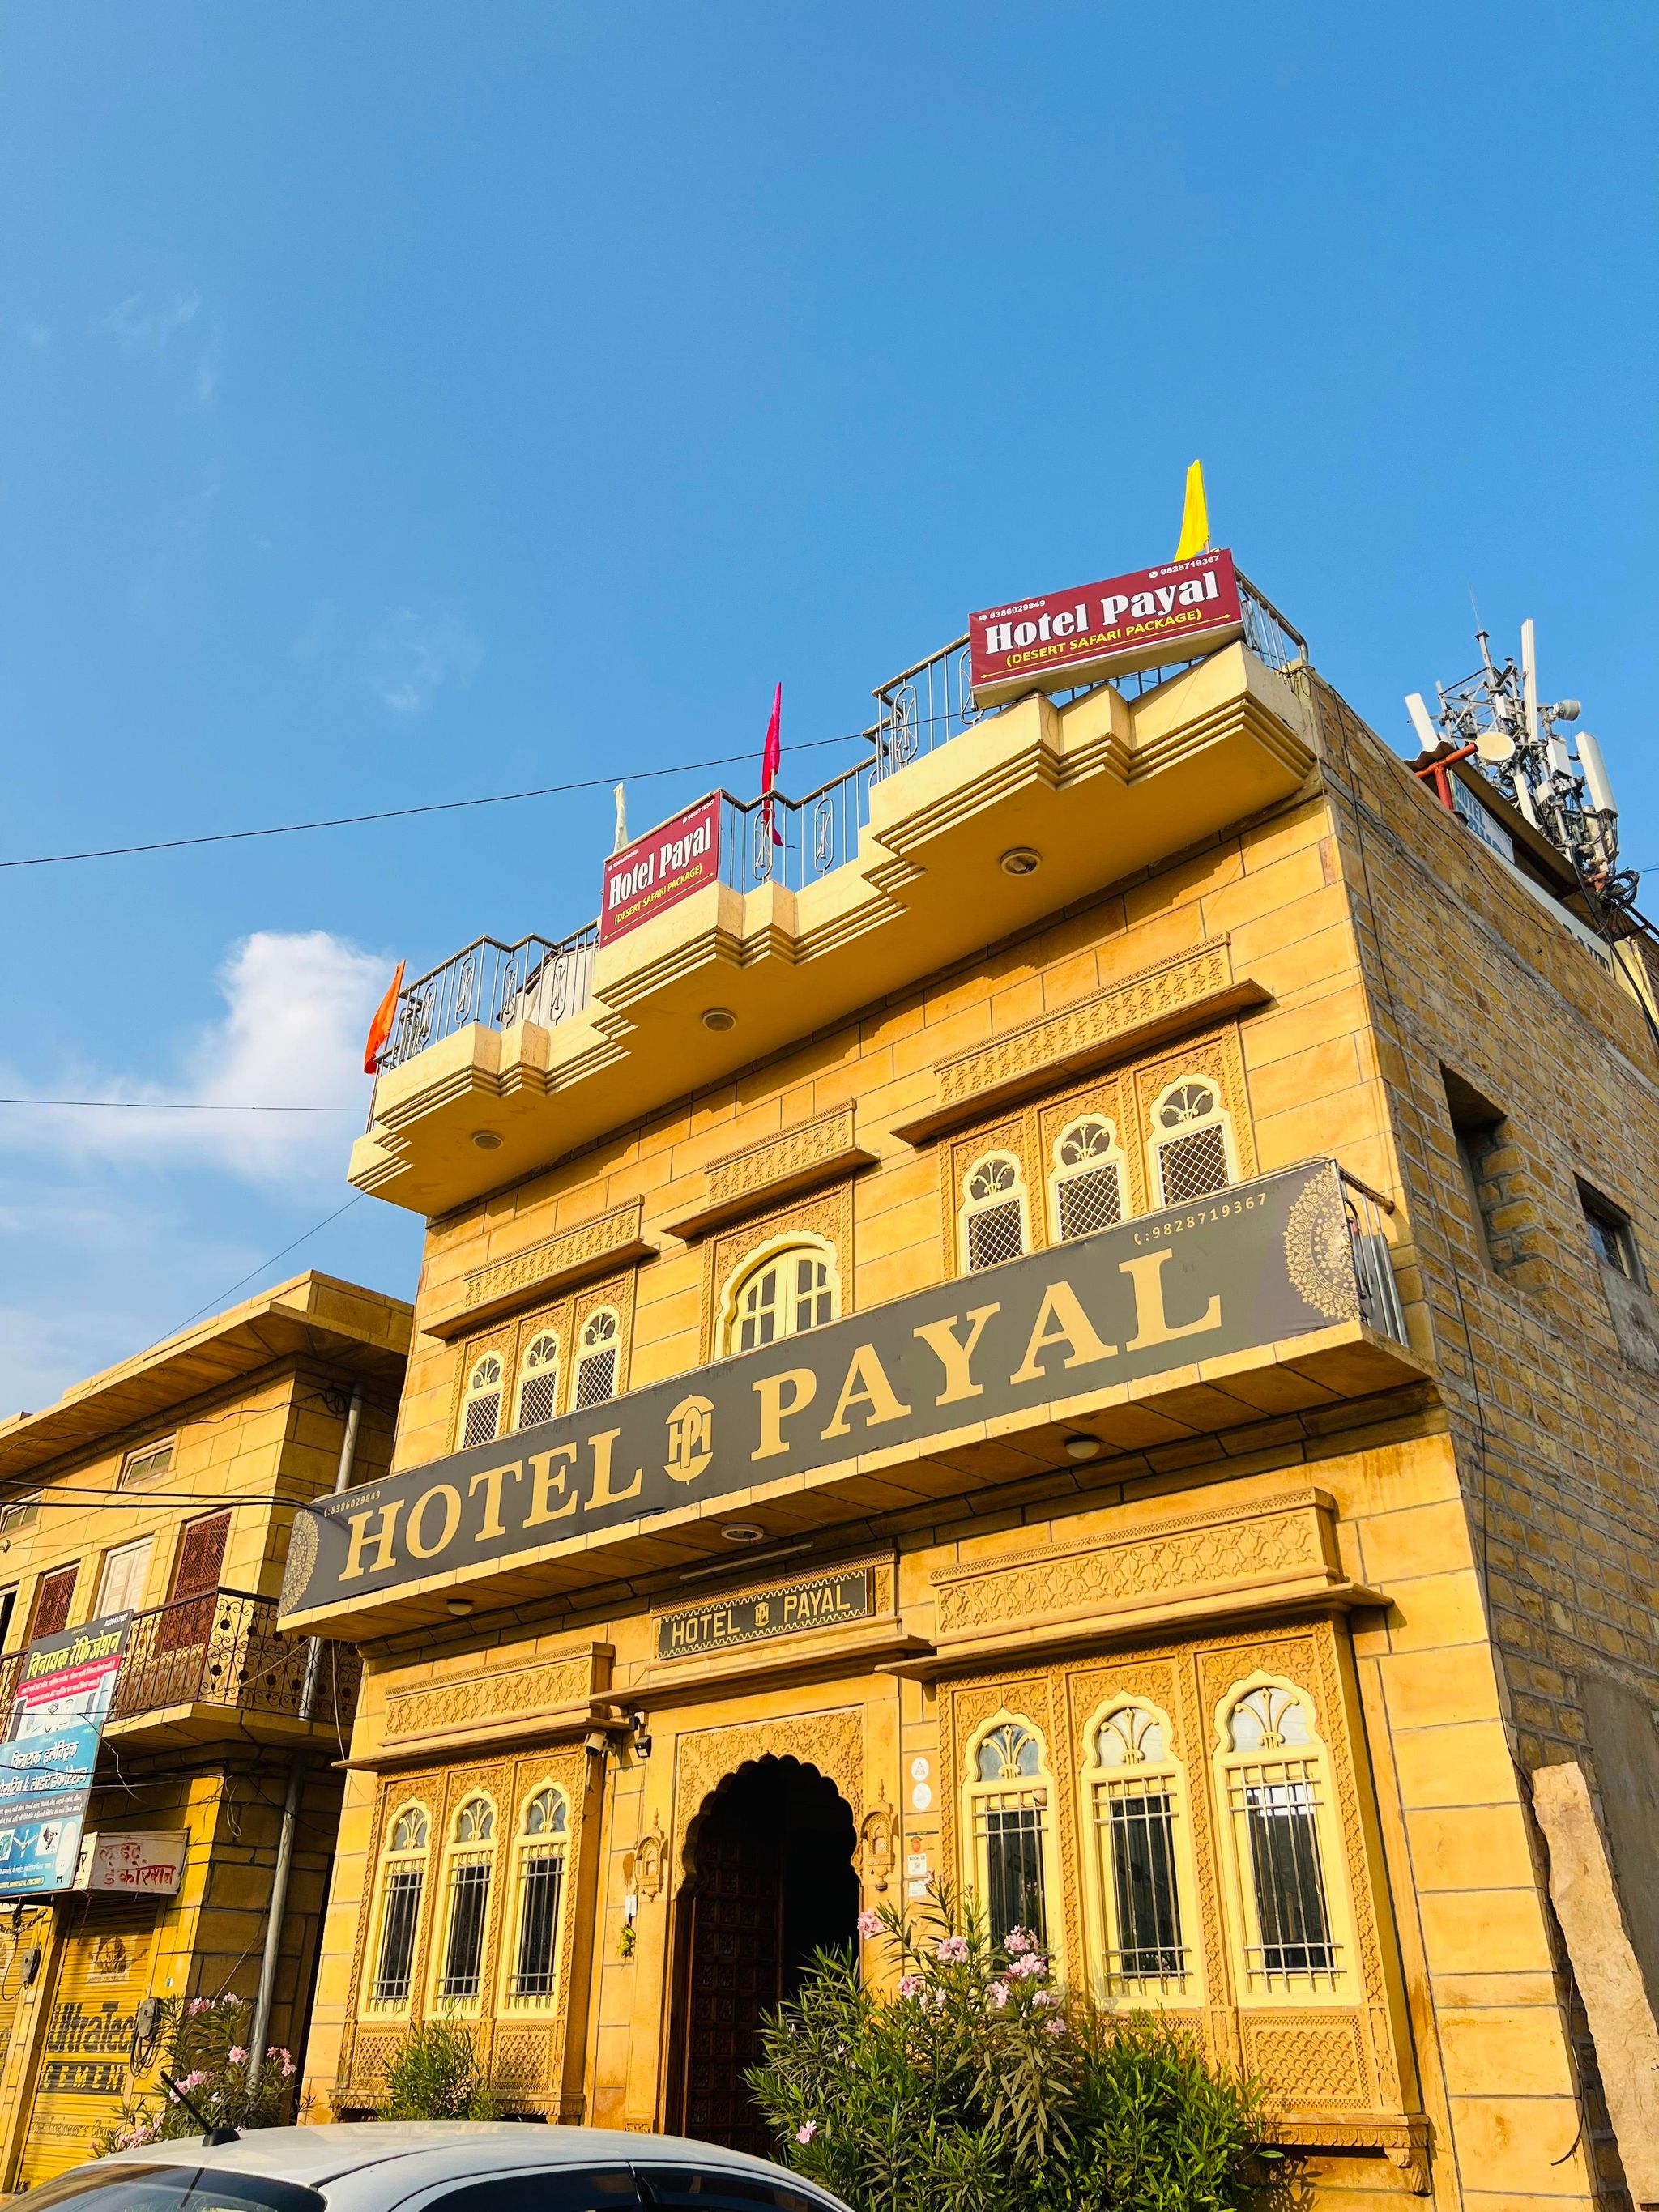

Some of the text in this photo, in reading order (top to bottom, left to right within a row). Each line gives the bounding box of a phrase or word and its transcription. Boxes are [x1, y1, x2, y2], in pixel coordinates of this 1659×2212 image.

[1160, 555, 1220, 575] 9828719367
[985, 570, 1220, 655] Hotel Payal
[989, 600, 1046, 619] 8386029849
[1005, 608, 1202, 667] (DESERT SAFARI PACKAGE)
[608, 816, 711, 910] Hotel Payal
[614, 863, 703, 926] (DESERT SAFARI PACKAGE)
[338, 1427, 643, 1582] HOTEL
[751, 1248, 1222, 1462] PAYAL
[672, 1609, 740, 1647] HOTEL
[783, 1583, 851, 1622] PAYAL
[26, 1647, 71, 1680] विनायक
[11, 1750, 43, 1769] विनायक
